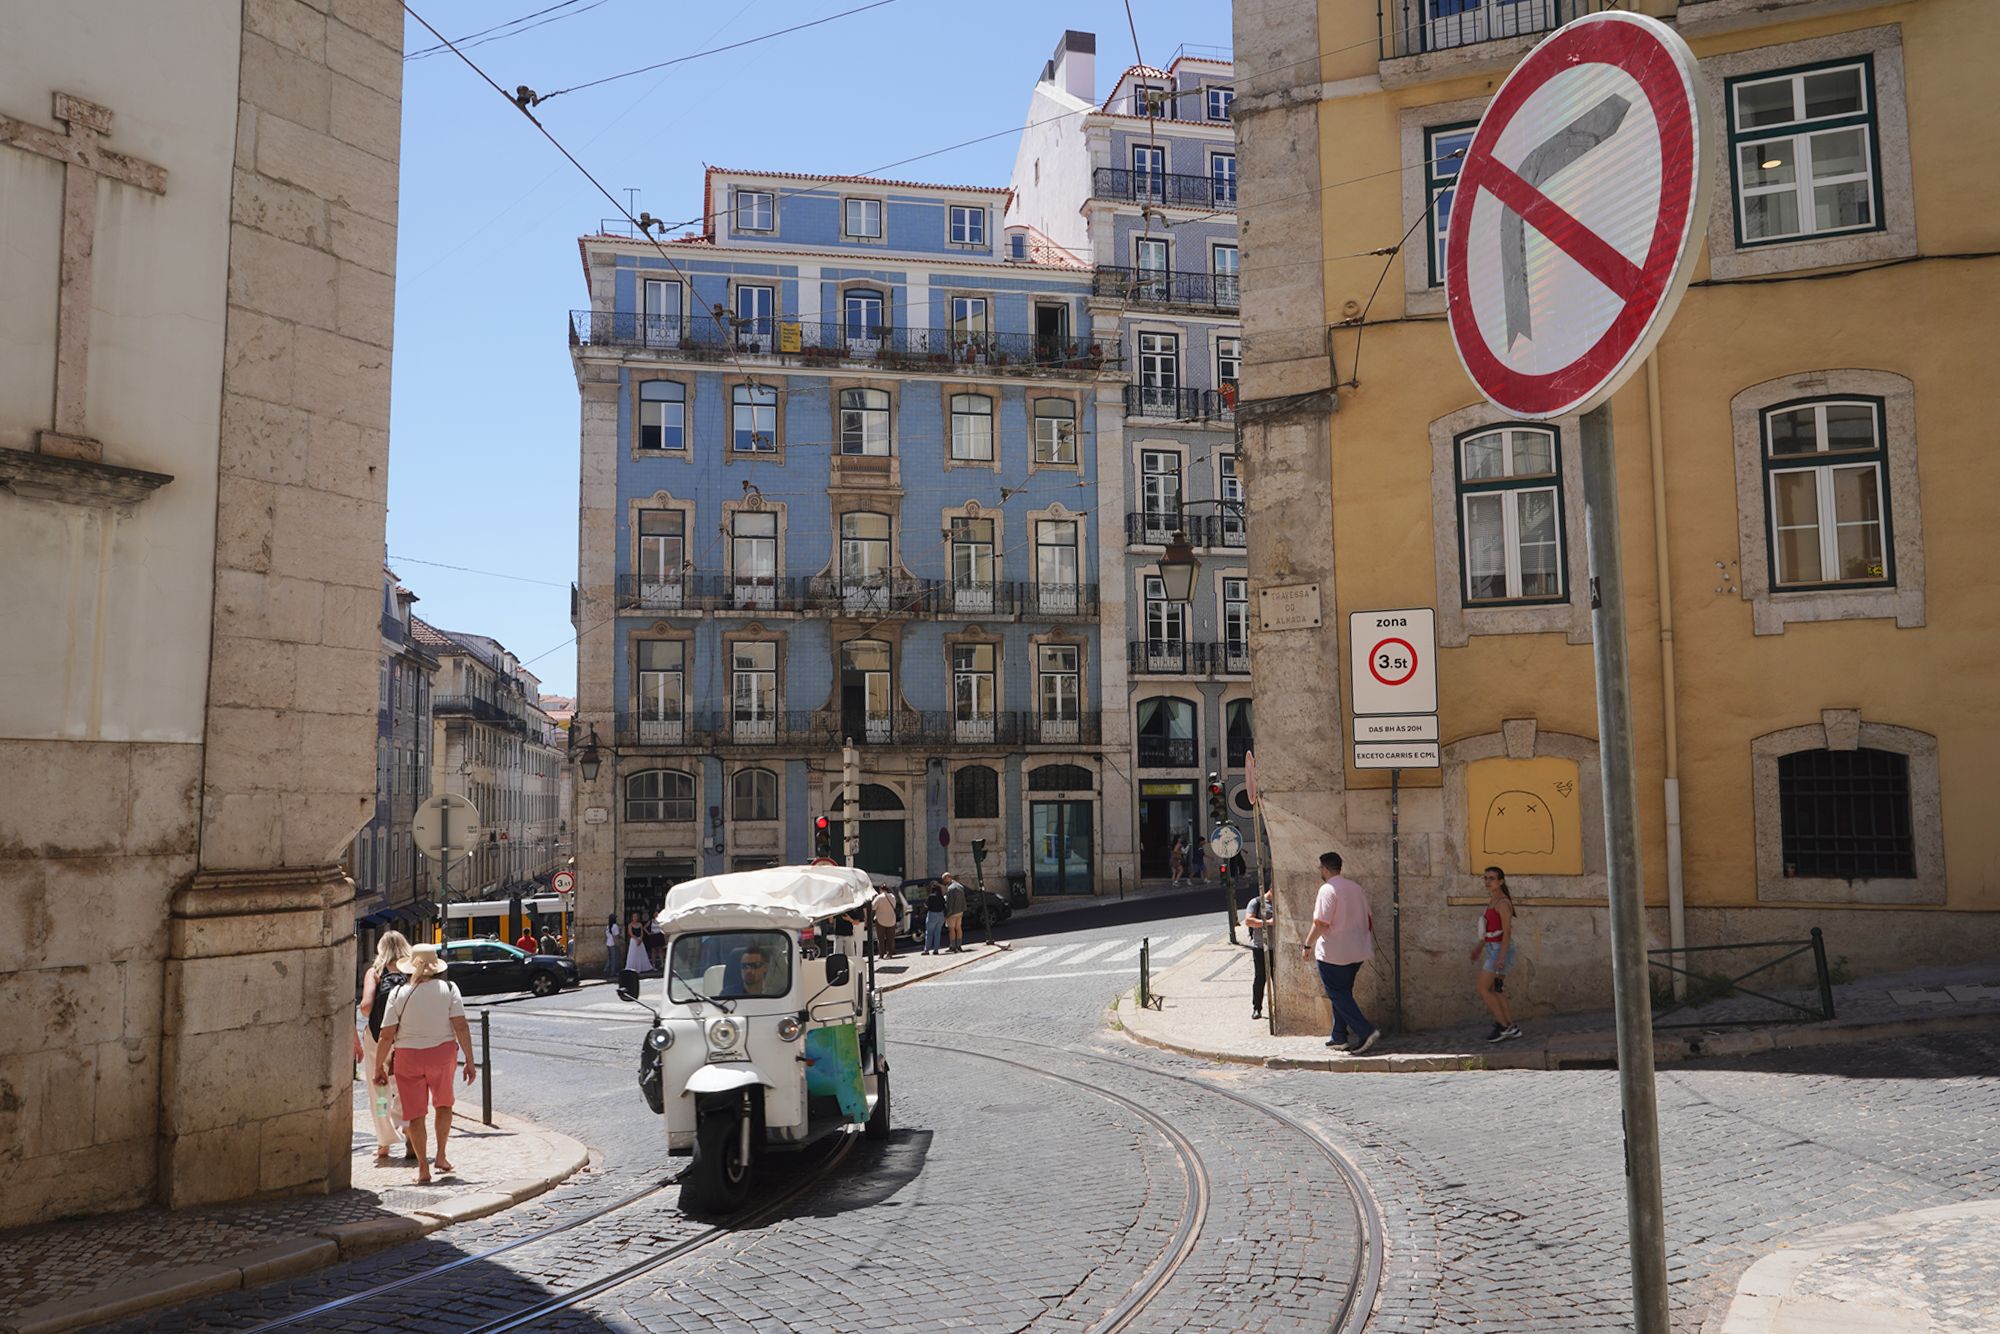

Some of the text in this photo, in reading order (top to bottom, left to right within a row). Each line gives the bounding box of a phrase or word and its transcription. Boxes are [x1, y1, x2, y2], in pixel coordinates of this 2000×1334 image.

[1271, 590, 1310, 600] TRAVESSA
[1285, 603, 1295, 612] DO
[1275, 616, 1306, 625] ALMADA
[1376, 618, 1407, 627] zona
[1378, 655, 1408, 668] 3.5t
